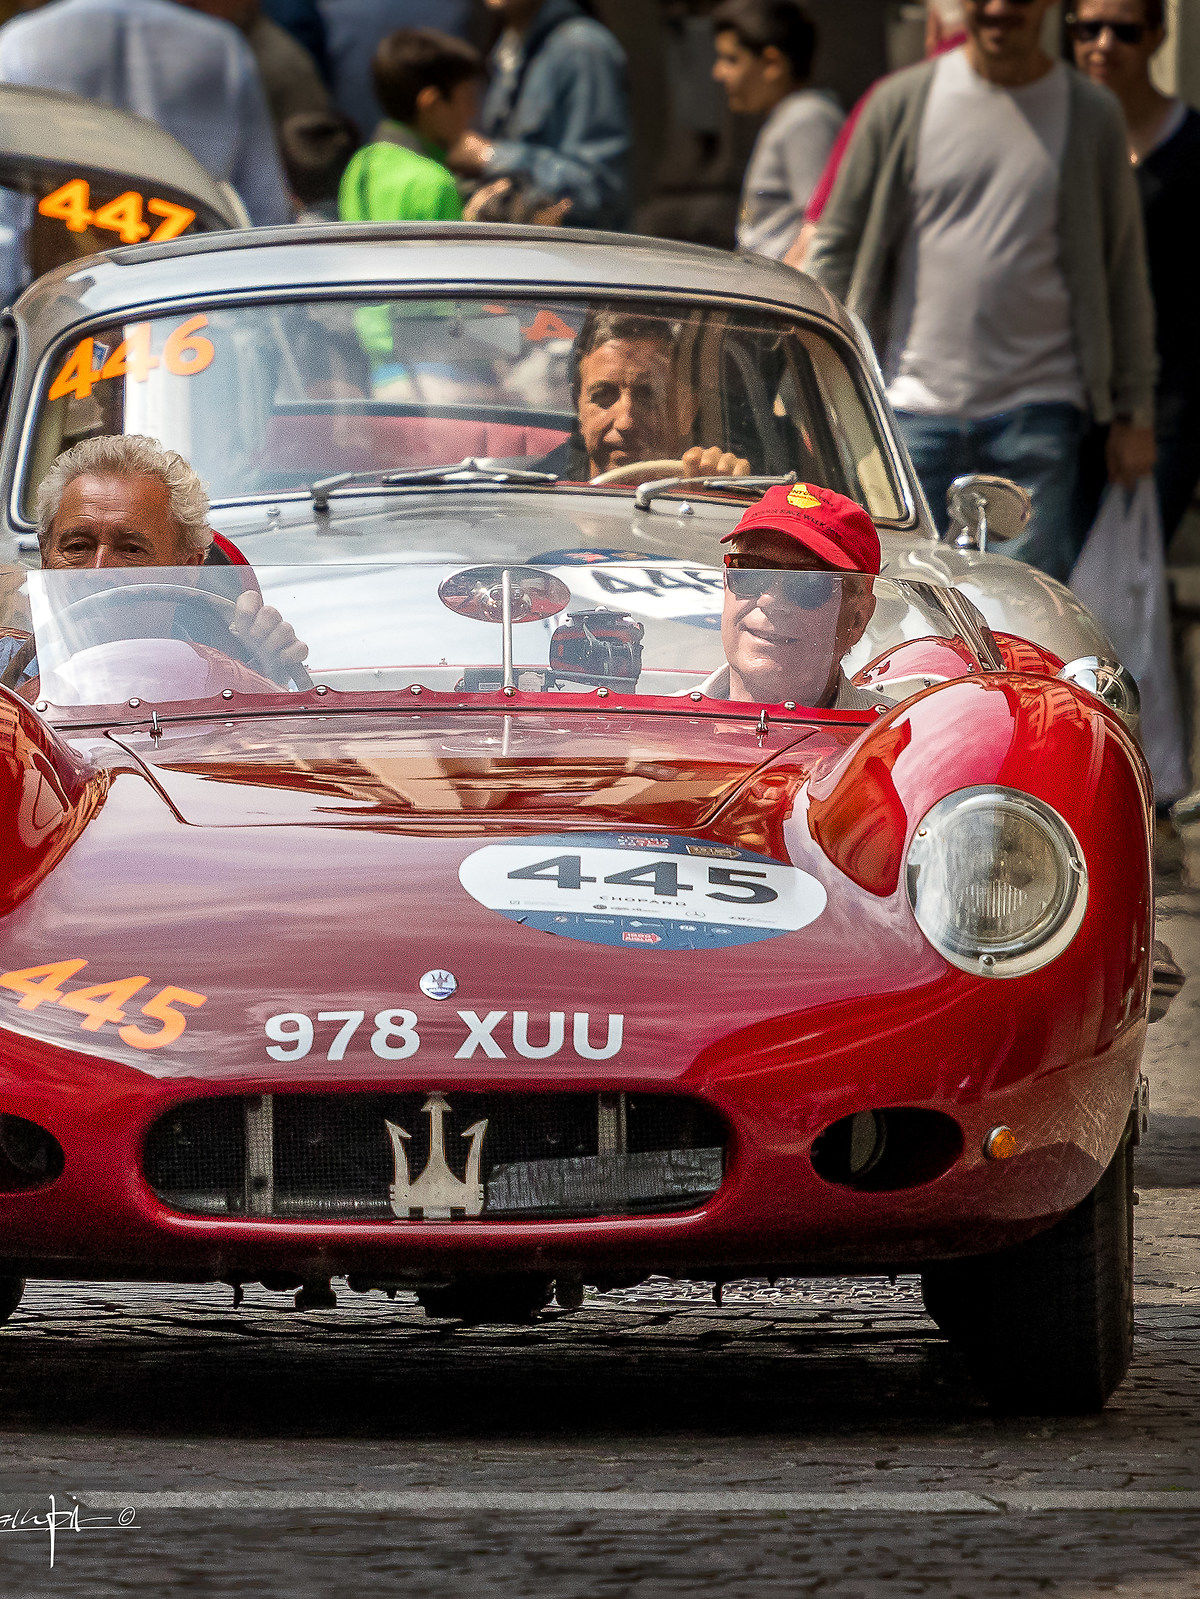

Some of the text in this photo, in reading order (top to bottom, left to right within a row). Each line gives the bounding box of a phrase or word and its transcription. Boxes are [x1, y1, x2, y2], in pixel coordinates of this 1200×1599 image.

[38, 178, 196, 244] 447
[48, 314, 215, 401] 446
[506, 854, 779, 905] 445
[599, 895, 687, 907] CHOPARD
[264, 1008, 625, 1063] 978 XUU
